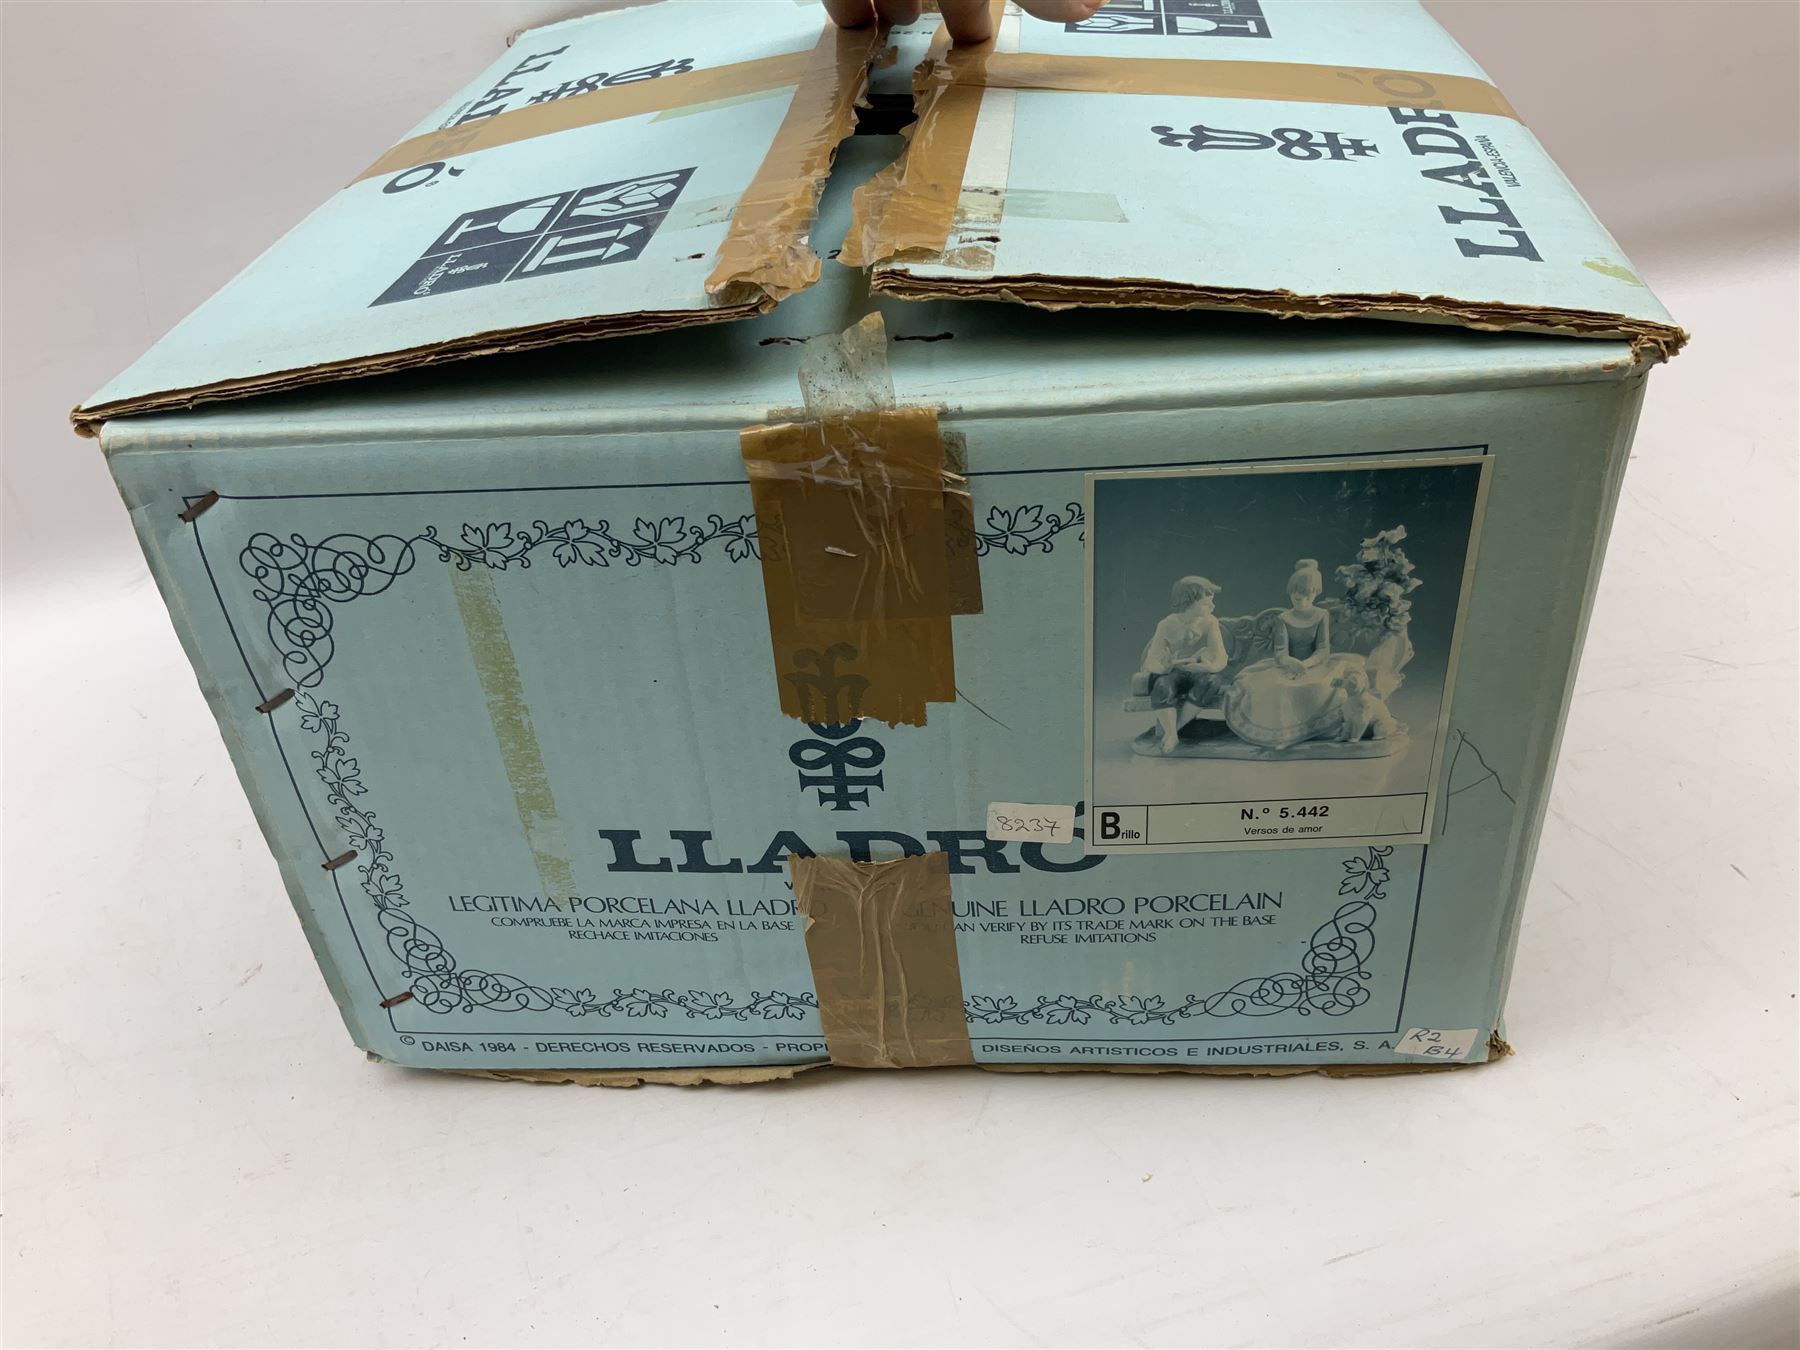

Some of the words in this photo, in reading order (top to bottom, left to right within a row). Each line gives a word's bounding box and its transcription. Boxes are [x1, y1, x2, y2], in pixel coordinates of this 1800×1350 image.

[1279, 805, 1330, 819] 5.442
[996, 815, 1062, 837] 8237
[1100, 811, 1141, 840] Brillo
[1244, 826, 1279, 836] Versos
[1282, 825, 1295, 834] de
[1298, 825, 1323, 834] amor
[448, 895, 562, 912] LEGITIMA
[568, 896, 719, 916] PORCELANA
[1020, 896, 1126, 917] LLADRO
[1134, 891, 1283, 914] PORCELAIN
[491, 916, 573, 928] COMPRUEBE
[577, 918, 595, 928] LA
[599, 918, 651, 929] MARCA
[654, 919, 712, 931] IMPRESA
[717, 920, 736, 931] EN
[739, 920, 757, 931] LA
[762, 920, 796, 932] BASE
[979, 922, 1027, 933] VERIFY
[1031, 921, 1046, 932] BY
[1052, 920, 1073, 932] ITS
[1075, 919, 1125, 931] TRADE
[1129, 918, 1174, 930] MARK
[1179, 917, 1205, 929] ON
[1210, 916, 1239, 928] THE
[1243, 914, 1277, 926] BASE
[568, 930, 630, 941] RECHACE
[634, 931, 719, 943] IMITACIONES
[1020, 933, 1068, 945] REFUSE
[1074, 932, 1157, 945] IMITATIONS
[1408, 1028, 1442, 1043] R2
[421, 1041, 473, 1053] DAISA
[480, 1041, 516, 1053] 1984
[535, 1042, 631, 1053] DERECHOS
[637, 1042, 756, 1054] RESERVADOS
[981, 1043, 1061, 1054] DISEÑOS
[1070, 1046, 1178, 1057] ARTISTICOS
[1187, 1047, 1199, 1057] E
[1353, 1040, 1369, 1050] S.
